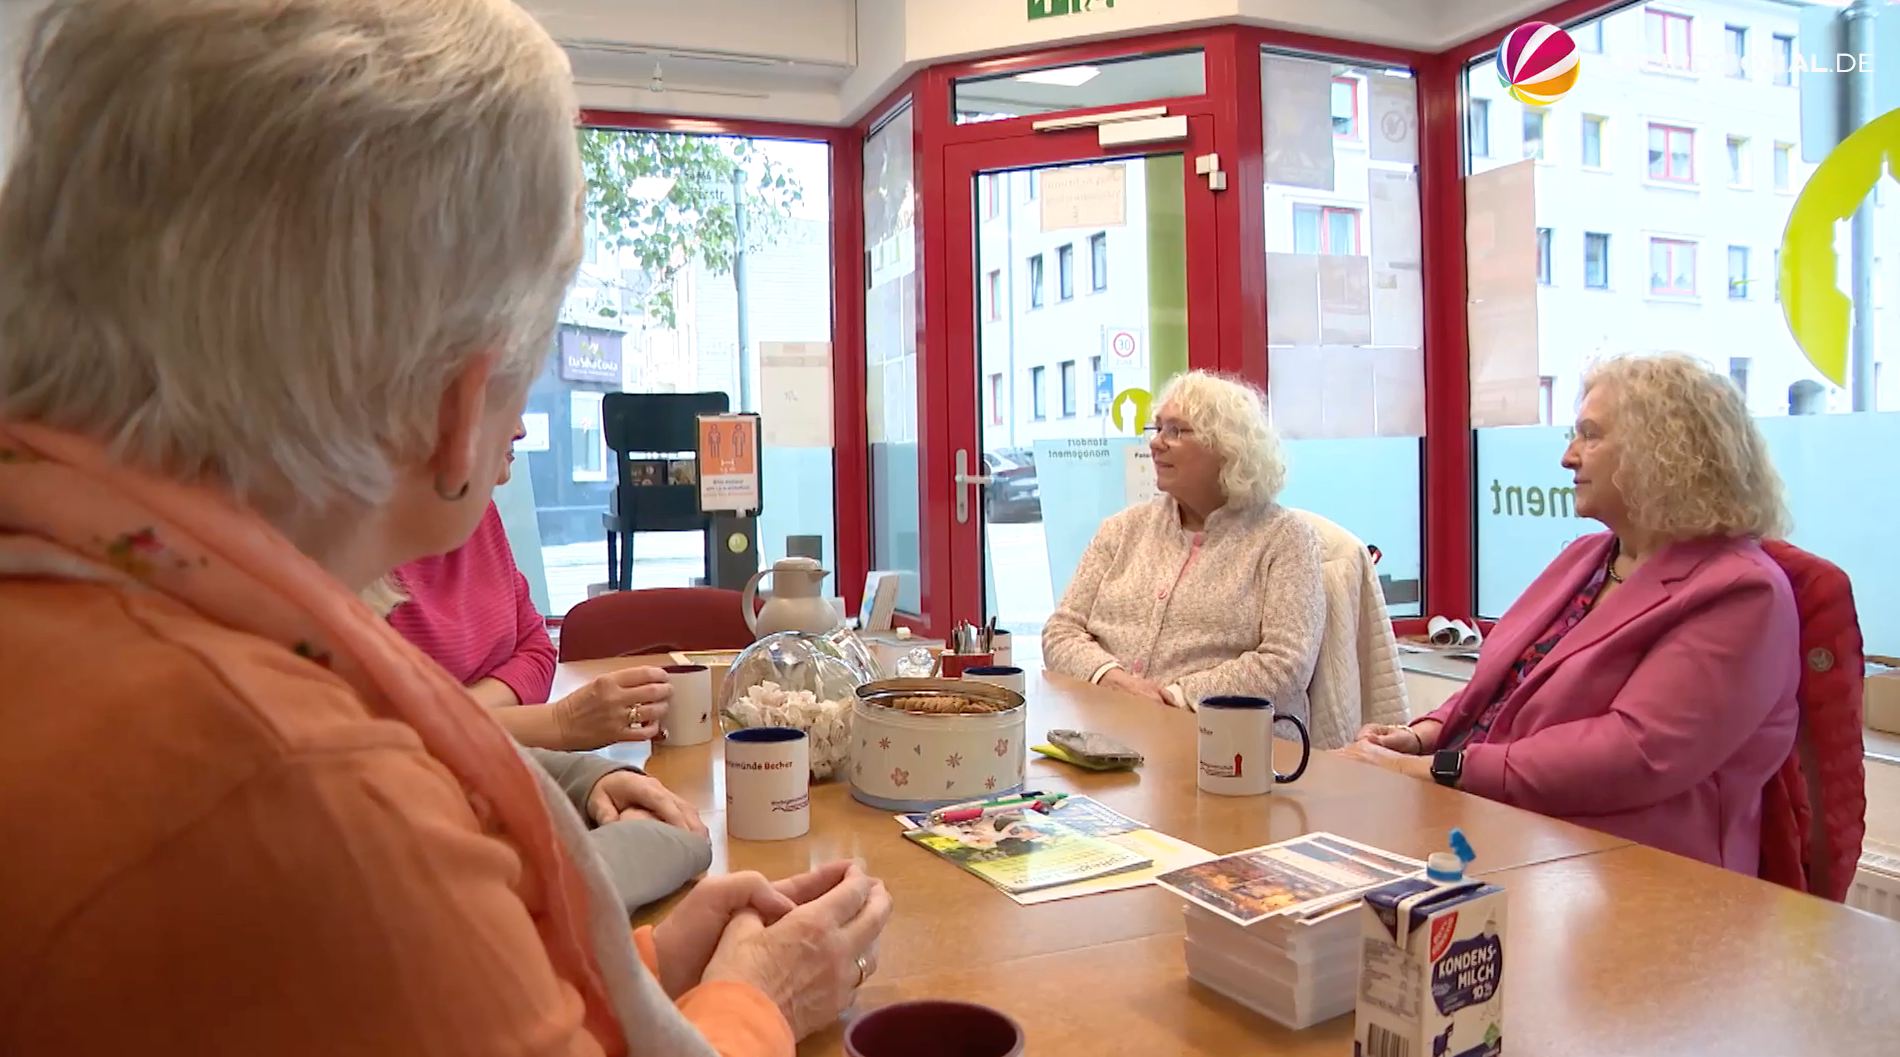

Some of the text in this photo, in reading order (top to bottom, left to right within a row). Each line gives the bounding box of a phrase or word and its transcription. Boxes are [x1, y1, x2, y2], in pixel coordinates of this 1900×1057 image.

[1117, 338, 1131, 351] 30
[1097, 374, 1107, 387] P
[764, 760, 793, 770] Becher
[1438, 943, 1497, 980] KONDENS-
[1457, 962, 1495, 990] MILCH
